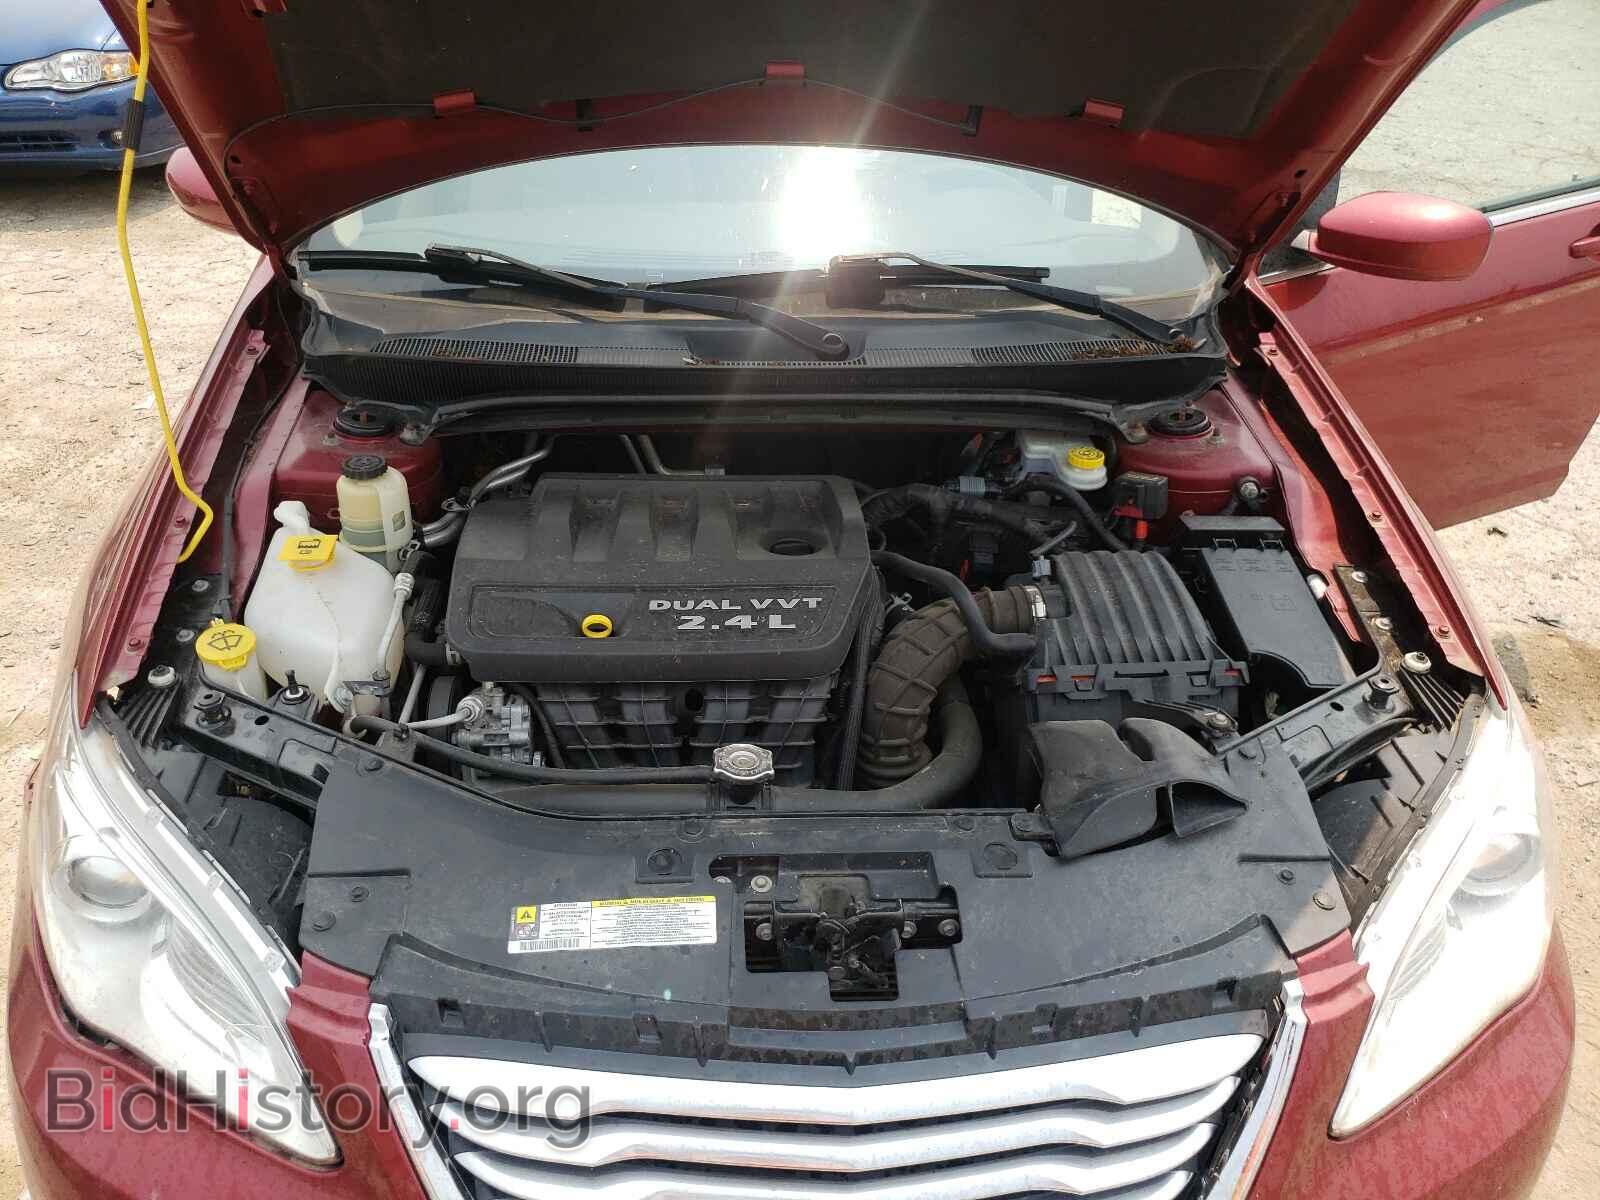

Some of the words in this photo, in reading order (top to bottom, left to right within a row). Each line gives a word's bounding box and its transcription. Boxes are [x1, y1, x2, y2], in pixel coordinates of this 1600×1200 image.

[648, 599, 742, 610] DUAL
[750, 597, 823, 609] VVT
[677, 614, 797, 630] 2.4L
